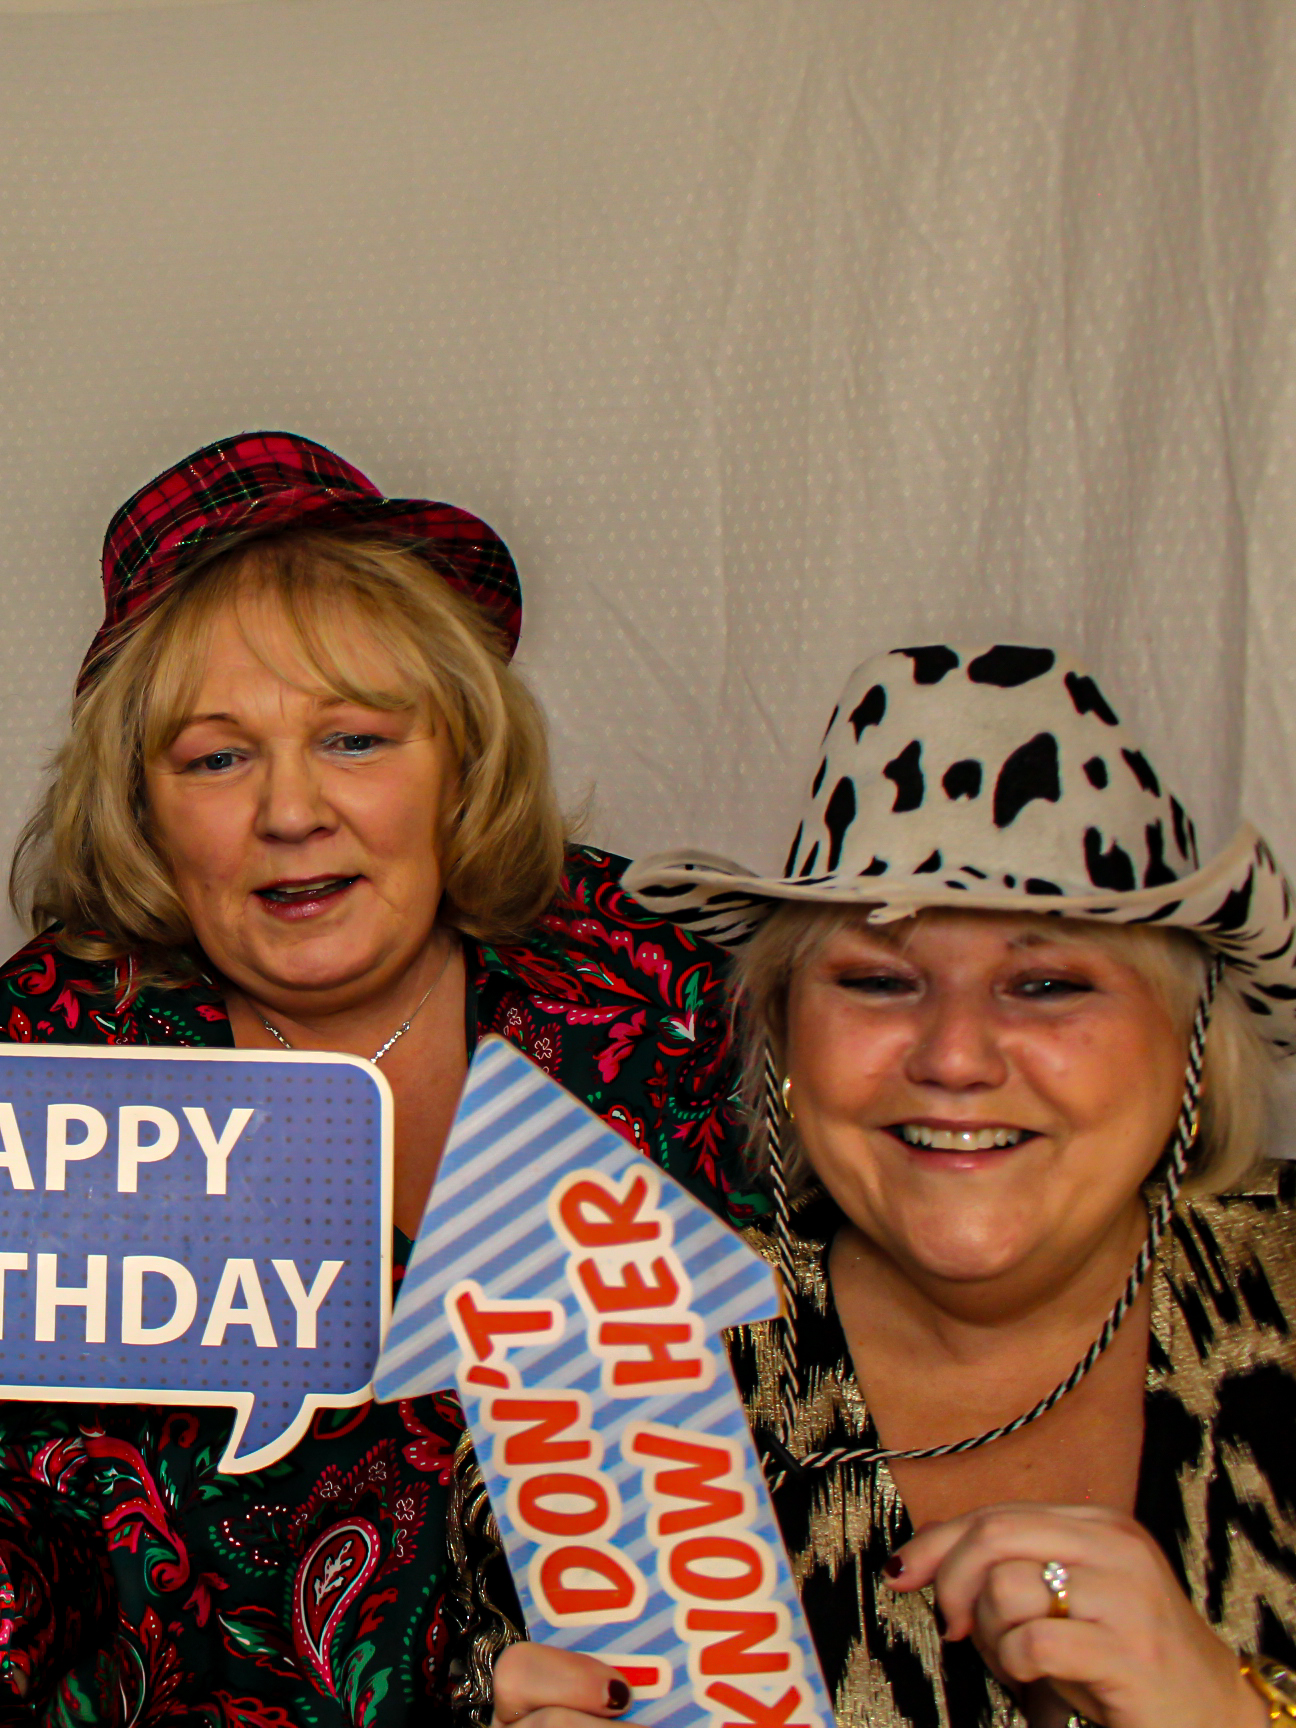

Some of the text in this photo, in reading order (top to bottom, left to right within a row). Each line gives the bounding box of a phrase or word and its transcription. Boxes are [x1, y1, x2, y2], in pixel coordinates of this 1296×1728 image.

[456, 1292, 636, 1616] DON'T
[558, 1176, 812, 1728] KNOW HER
